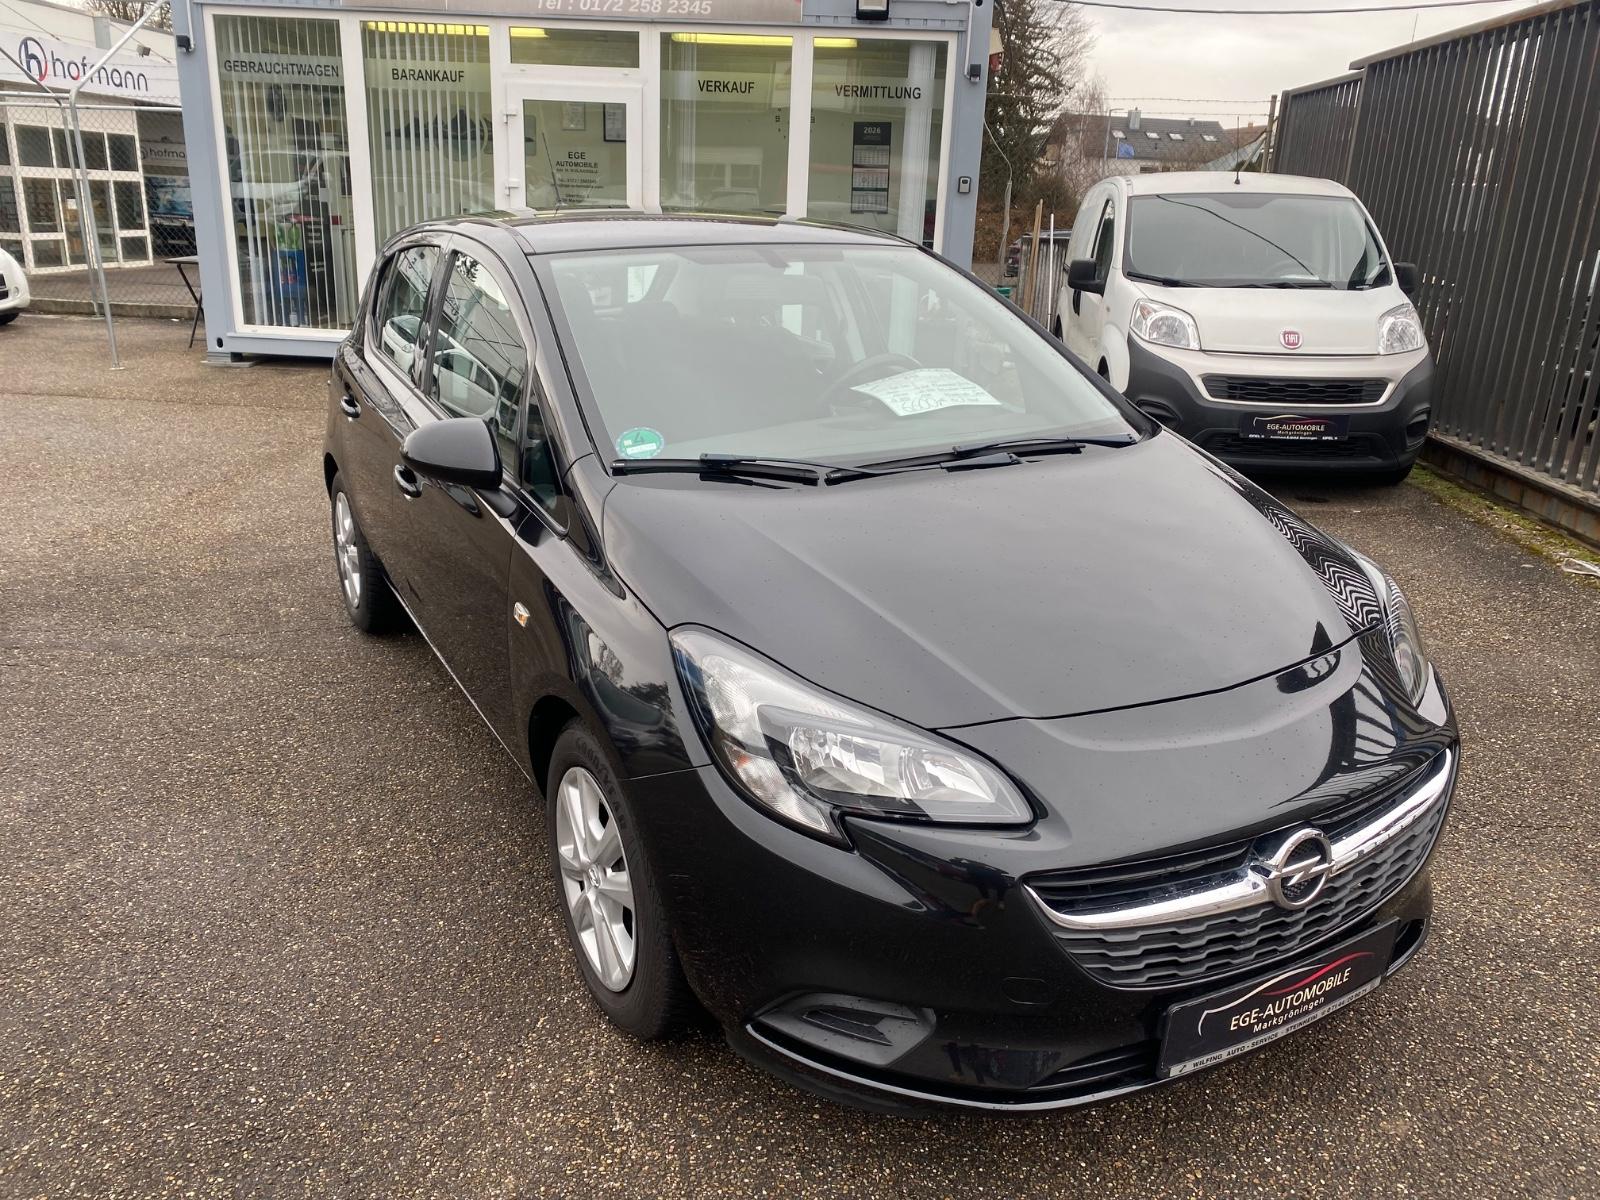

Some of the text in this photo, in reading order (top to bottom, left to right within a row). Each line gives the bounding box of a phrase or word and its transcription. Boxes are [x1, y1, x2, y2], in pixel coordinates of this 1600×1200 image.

[579, 0, 623, 12] 0172
[628, 0, 662, 13] 258
[667, 0, 712, 14] 2345
[223, 59, 339, 77] GEBRAUCHTWAGEN
[391, 68, 465, 83] BARANKAUF
[698, 79, 755, 94] VERKAUF
[835, 83, 921, 100] VERMITTLUNG
[863, 126, 881, 134] 2026
[149, 147, 186, 159] hofma
[567, 151, 587, 160] EGE
[555, 160, 599, 168] AUTOMOBILE
[1284, 333, 1299, 344] FIAT
[1266, 423, 1326, 431] EGE-AUTOMOBILE
[1229, 967, 1352, 1031] EGE-AUTOMOBILE
[1253, 996, 1325, 1033] Markgröningen
[1192, 1053, 1223, 1069] WILFING
